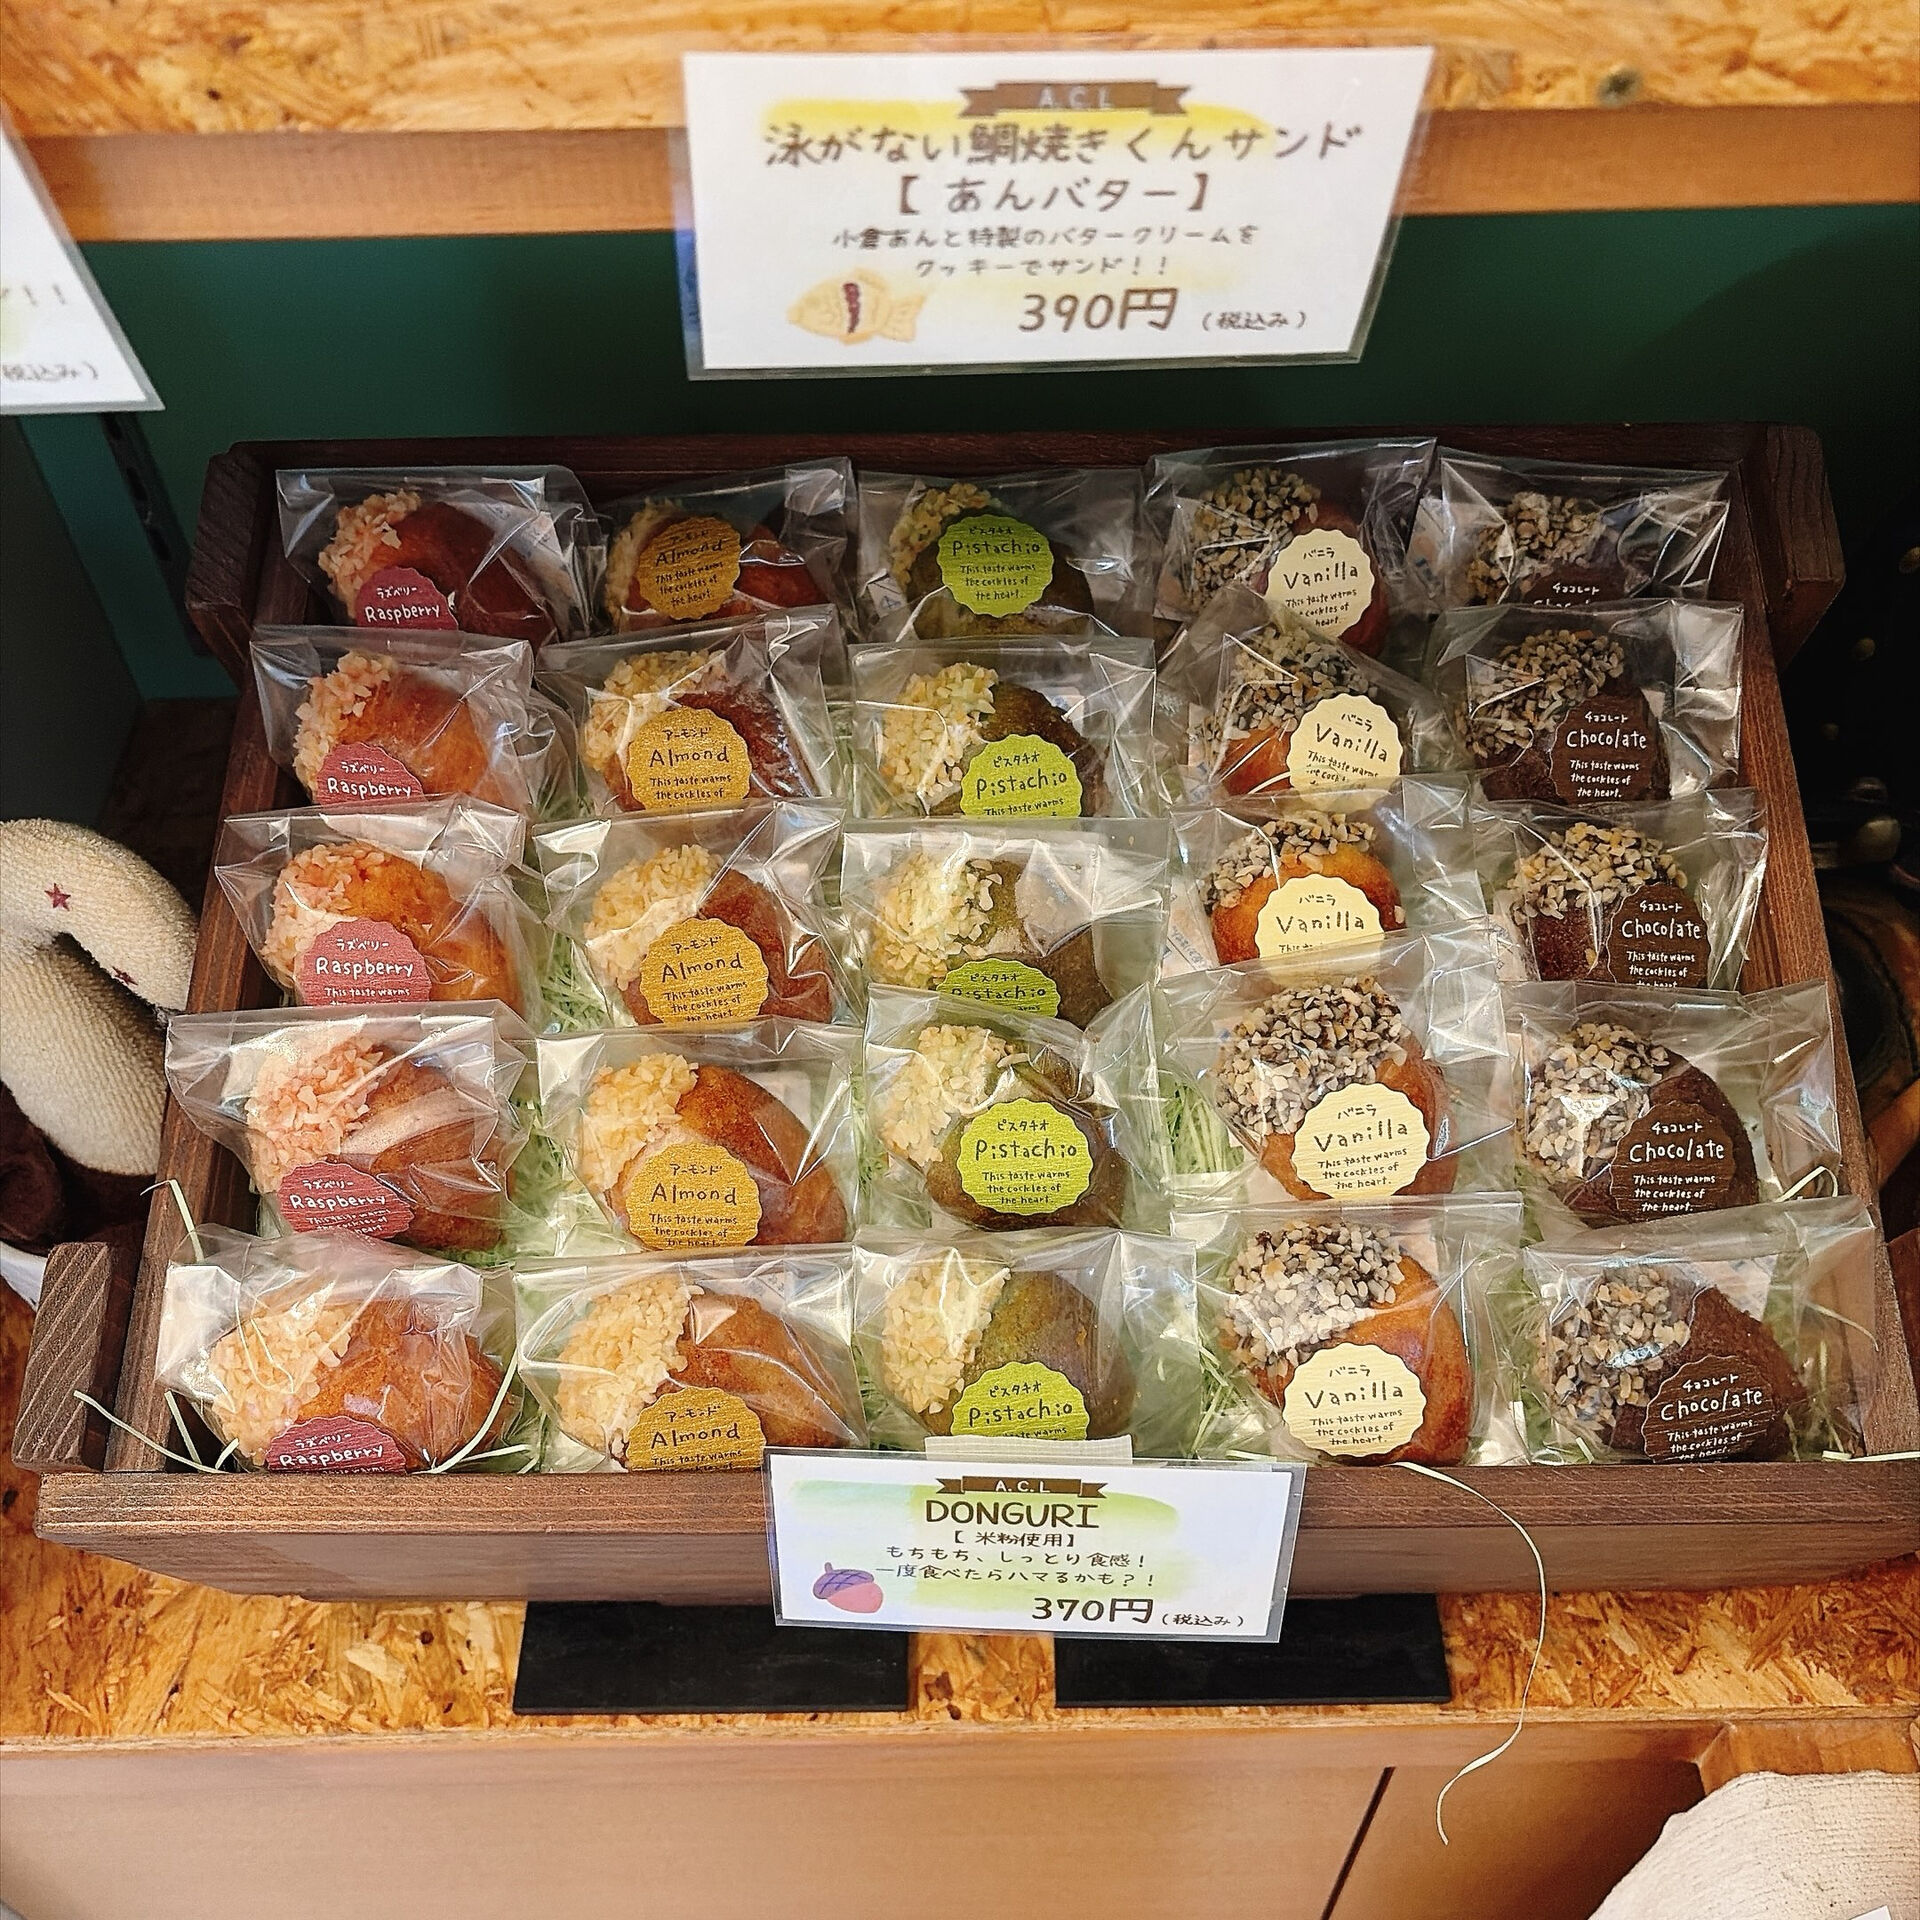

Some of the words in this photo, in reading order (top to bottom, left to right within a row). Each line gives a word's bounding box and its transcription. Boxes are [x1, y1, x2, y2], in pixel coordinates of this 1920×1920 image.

[765, 121, 1362, 169] 泳がない鯛焼きくんサンド
[834, 225, 1258, 250] 小倉あんと特製のバタークリームを
[1018, 287, 1179, 333] 390円
[655, 539, 723, 567] Almond
[953, 540, 1041, 556] Pistachio
[1303, 547, 1335, 559] バニラ
[1018, 575, 1029, 586] of
[1283, 561, 1358, 590] Vanilla
[376, 585, 418, 600] ラズベリー
[975, 591, 992, 601] the
[1286, 598, 1304, 608] This
[1306, 594, 1328, 606] taste
[1330, 589, 1358, 600] warms
[365, 604, 440, 624] Raspberry
[1305, 606, 1338, 618] cockles
[1340, 602, 1349, 613] of
[1341, 713, 1373, 732] バニラ
[1584, 711, 1629, 724] チョコレート
[662, 727, 711, 740] アーモンド
[1566, 728, 1647, 749] Chocolate
[1315, 722, 1388, 763] Vanilla
[650, 746, 730, 768] Almond
[993, 751, 1040, 768] ピスタチオ
[1308, 750, 1326, 763] This
[1327, 755, 1350, 772] taste
[1569, 759, 1588, 770] This
[1591, 760, 1612, 771] taste
[1613, 761, 1640, 771] warms
[341, 761, 385, 774] ラズベリー
[650, 777, 670, 788] This
[675, 775, 698, 786] taste
[976, 768, 1067, 800] Pistachio
[1570, 773, 1586, 783] the
[1587, 774, 1619, 785] cockles
[1620, 774, 1631, 786] of
[327, 777, 411, 800] Raspberry
[655, 788, 671, 799] the
[674, 787, 711, 799] cockles
[713, 786, 725, 798] of
[1576, 787, 1591, 798] the
[1594, 787, 1622, 798] heart.
[984, 807, 1006, 817] This
[1008, 803, 1032, 814] taste
[1035, 798, 1064, 809] warms
[1299, 894, 1336, 906] バニラ
[1639, 899, 1683, 913] チョコレート
[1276, 910, 1364, 934] Vanilla
[1621, 917, 1701, 940] Chocolate
[336, 938, 389, 951] ラズベリー
[671, 935, 722, 955] アーモンド
[1626, 950, 1645, 962] This
[1646, 951, 1668, 963] taste
[1669, 953, 1695, 963] warms
[315, 956, 414, 980] Raspberry
[662, 953, 744, 983] Almond
[1628, 964, 1643, 976] the
[1645, 966, 1677, 978] cockles
[1678, 966, 1688, 978] of
[324, 987, 346, 997] This
[349, 987, 376, 997] taste
[378, 987, 411, 998] warms
[663, 991, 685, 1002] This
[690, 987, 715, 999] taste
[717, 981, 748, 993] warms
[952, 985, 1046, 1000] Pstachio
[671, 1002, 688, 1013] the
[690, 998, 730, 1012] cockles
[732, 994, 742, 1006] of
[1337, 1104, 1377, 1119] バニラ
[997, 1118, 1050, 1132] ピスタチオ
[1651, 1121, 1703, 1136] チョコレート
[1314, 1118, 1408, 1152] Vanilla
[975, 1138, 1077, 1161] Pistachio
[1629, 1138, 1725, 1163] Chocolate
[1318, 1159, 1342, 1170] This
[1344, 1154, 1372, 1168] taste
[1374, 1148, 1407, 1162] warms
[669, 1162, 722, 1176] アーモンド
[981, 1170, 1006, 1182] This
[1008, 1170, 1035, 1181] taste
[1037, 1169, 1070, 1181] warms
[1322, 1169, 1341, 1181] the
[1343, 1166, 1384, 1178] cockles
[1387, 1161, 1399, 1174] of
[988, 1183, 1005, 1194] the
[1006, 1183, 1048, 1194] cockles
[1050, 1182, 1062, 1193] of
[1336, 1179, 1355, 1190] the
[1357, 1177, 1391, 1189] heart.
[1633, 1174, 1655, 1185] This
[1657, 1174, 1684, 1186] taste
[1685, 1174, 1716, 1185] warms
[650, 1182, 737, 1206] Almond
[999, 1195, 1017, 1205] the
[1019, 1196, 1054, 1205] heart.
[1634, 1188, 1652, 1200] the
[1653, 1188, 1692, 1200] cockles
[1694, 1188, 1706, 1200] of
[289, 1194, 386, 1212] Raspberry
[1641, 1201, 1660, 1212] the
[1662, 1201, 1693, 1212] heart.
[649, 1213, 672, 1225] This
[675, 1214, 704, 1225] taste
[705, 1215, 738, 1226] warms
[653, 1226, 672, 1237] the
[673, 1227, 713, 1238] cockles
[717, 1228, 728, 1238] of
[1329, 1364, 1371, 1377] バニラ
[989, 1381, 1042, 1398] ピスタチオ
[1682, 1373, 1739, 1392] チョコレート
[1304, 1380, 1403, 1409] Vanilla
[969, 1398, 1073, 1427] Pistachio
[1661, 1388, 1762, 1420] Chocolate
[1310, 1416, 1334, 1428] This
[1337, 1413, 1366, 1425] taste
[1368, 1408, 1403, 1420] warms
[651, 1423, 740, 1449] Almond
[1033, 1427, 1067, 1438] warms
[1316, 1427, 1335, 1437] the
[1337, 1425, 1380, 1436] cockles
[1382, 1421, 1394, 1432] of
[1667, 1431, 1689, 1442] This
[1692, 1425, 1719, 1438] taste
[1720, 1419, 1753, 1432] warms
[1329, 1436, 1349, 1446] the
[1351, 1434, 1387, 1445] heart.
[1670, 1442, 1687, 1453] the
[1688, 1437, 1729, 1451] cockles
[1730, 1432, 1742, 1444] of
[279, 1445, 383, 1467] Raspberry
[709, 1450, 743, 1462] warms
[926, 1499, 1099, 1528] DONGURI
[954, 1530, 1075, 1549] 【米粉使用】
[1031, 1597, 1154, 1624] 370円
[1162, 1612, 1244, 1629] （税込み）
